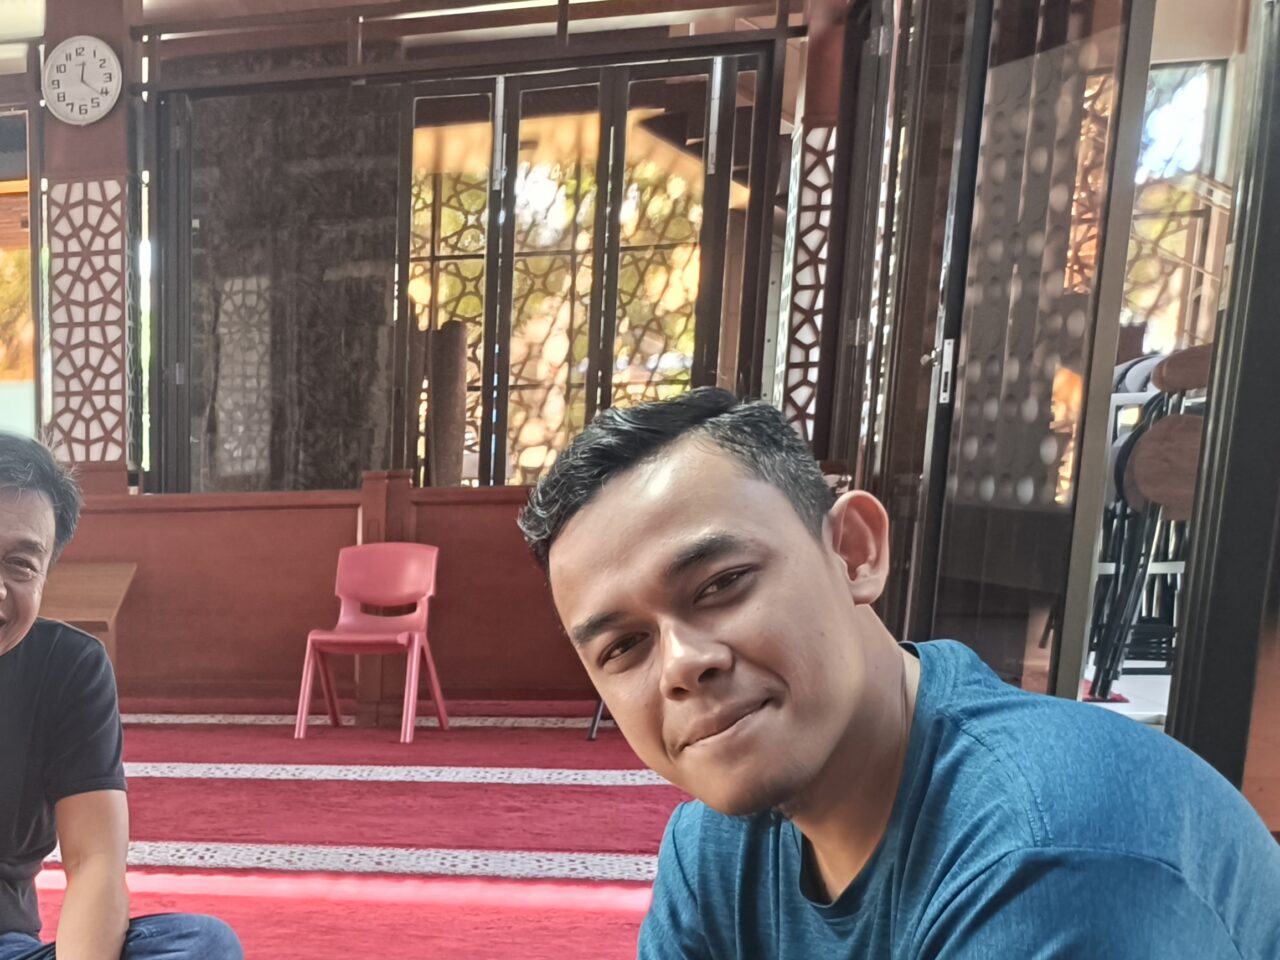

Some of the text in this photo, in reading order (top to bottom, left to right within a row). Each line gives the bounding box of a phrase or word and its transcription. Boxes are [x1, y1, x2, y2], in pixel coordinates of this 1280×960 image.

[65, 52, 72, 62] 11
[75, 46, 85, 57] 12
[56, 63, 66, 74] 10
[99, 58, 106, 68] 2
[103, 72, 112, 83] 3
[51, 79, 60, 90] 9
[57, 91, 66, 102] 8
[100, 87, 110, 96] 4
[65, 102, 74, 113] 7
[91, 97, 100, 108] 5
[79, 104, 88, 115] 6
